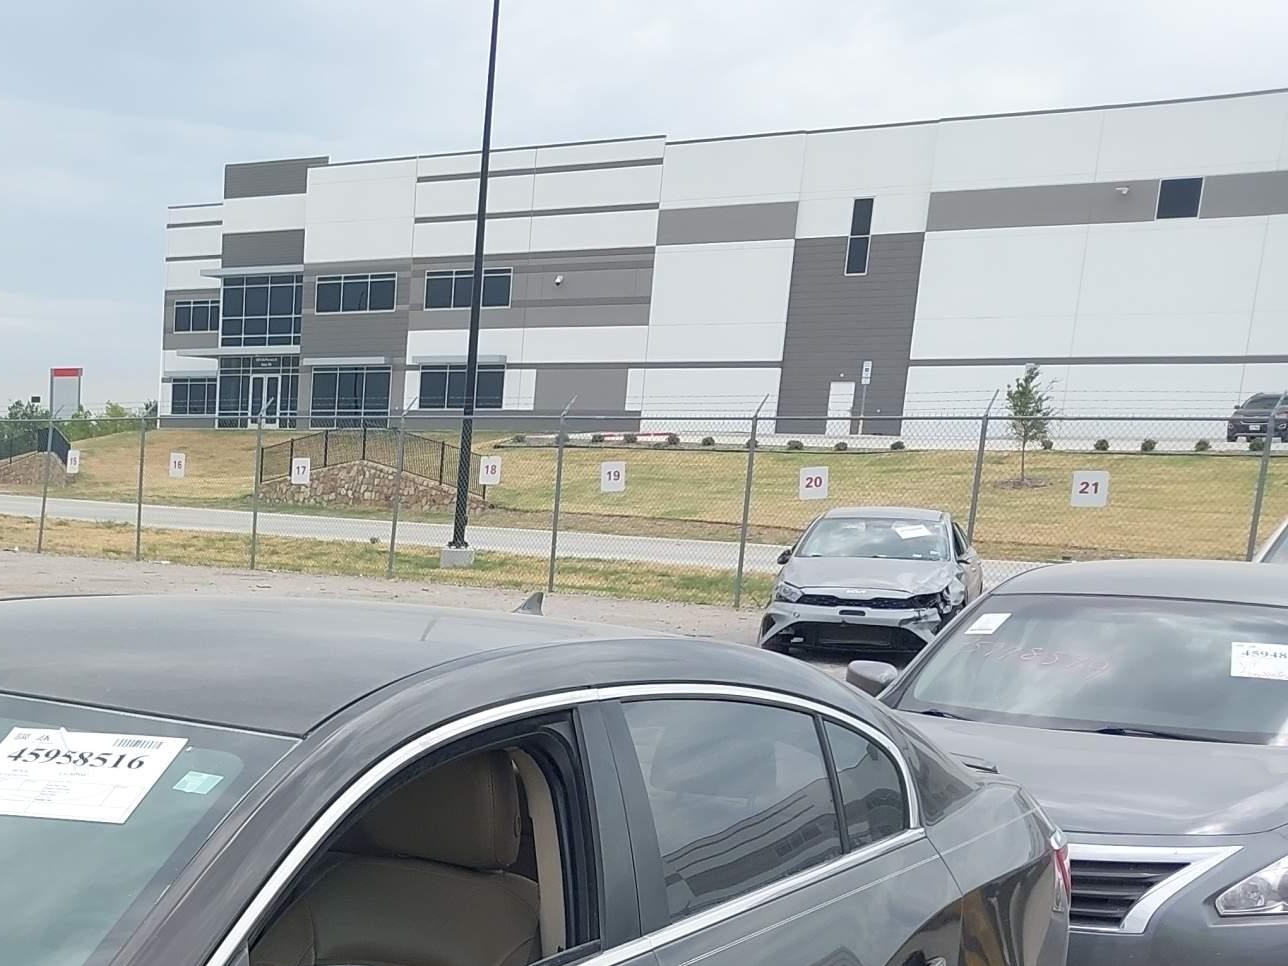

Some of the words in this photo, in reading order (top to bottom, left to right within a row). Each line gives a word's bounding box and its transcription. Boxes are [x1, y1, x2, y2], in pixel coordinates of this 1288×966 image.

[70, 457, 78, 466] 15
[173, 460, 182, 469] 16
[295, 465, 307, 475] 17
[485, 464, 497, 475] 18
[606, 470, 620, 482] 19
[805, 476, 823, 488] 20
[1078, 481, 1100, 494] 21
[7, 747, 149, 769] 45958516
